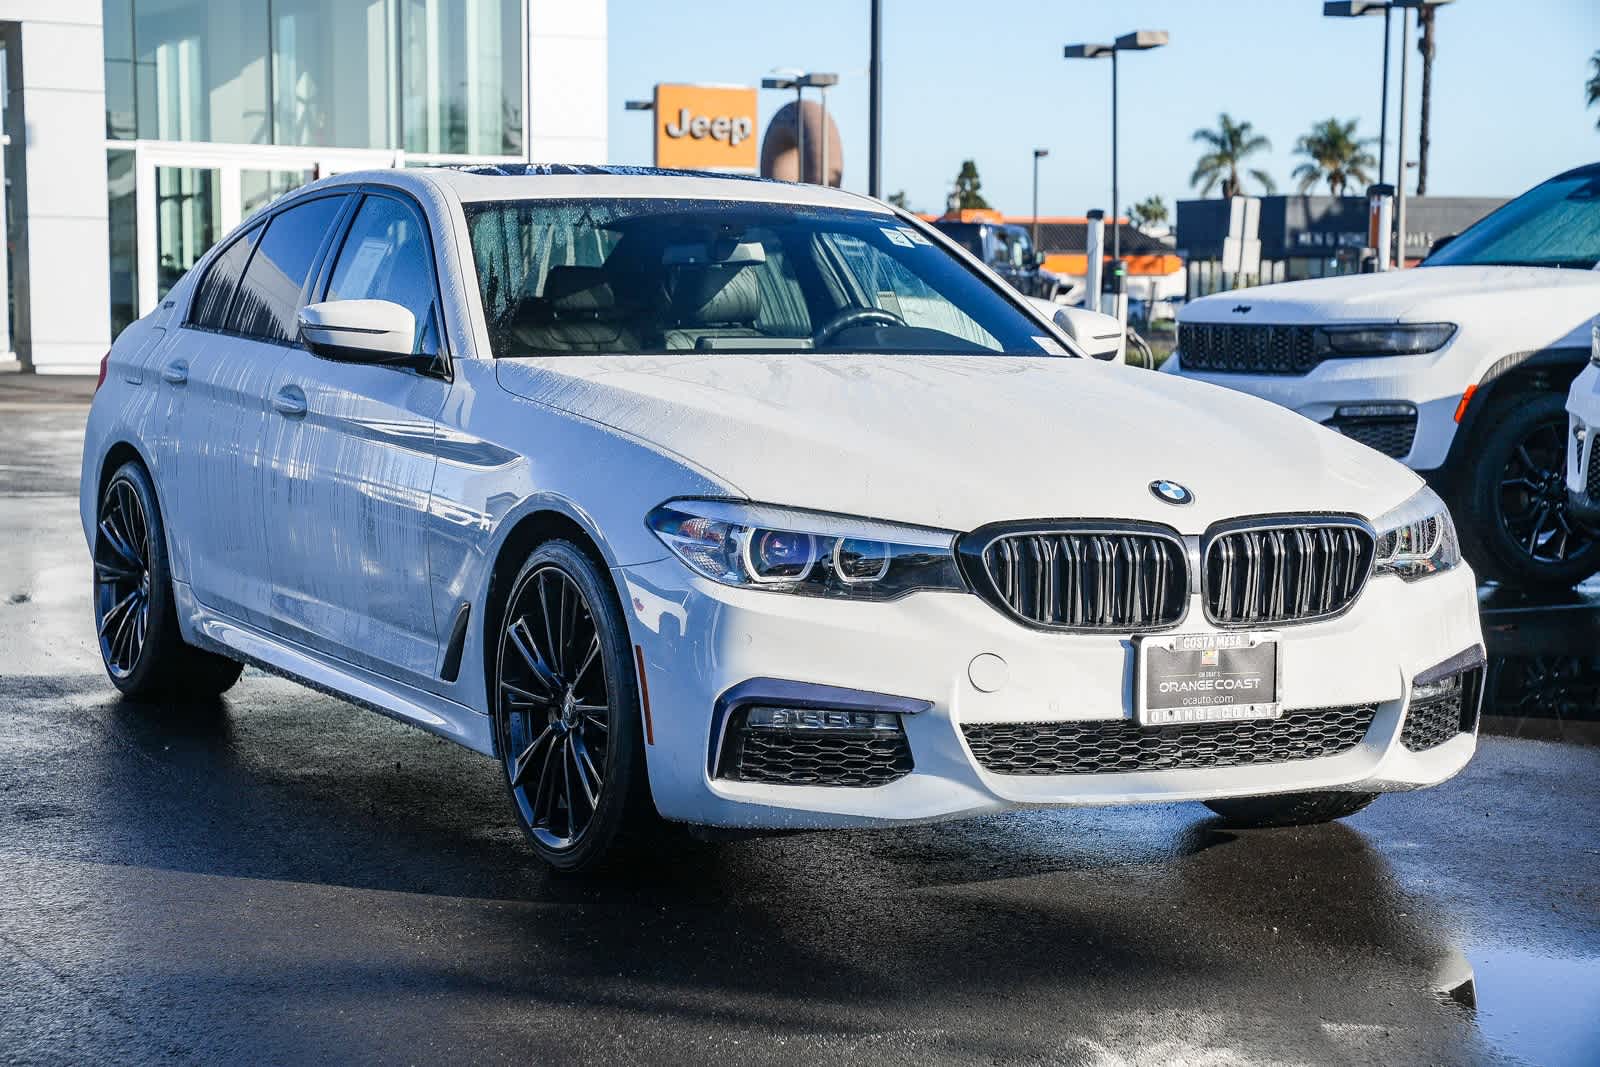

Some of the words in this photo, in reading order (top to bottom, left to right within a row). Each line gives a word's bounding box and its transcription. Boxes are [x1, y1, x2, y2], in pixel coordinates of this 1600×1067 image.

[665, 108, 752, 147] Jeep
[1184, 636, 1214, 649] COSTA
[1159, 681, 1214, 693] ORANGE
[1215, 678, 1261, 690] COAST
[1182, 694, 1234, 706] ocauto.com
